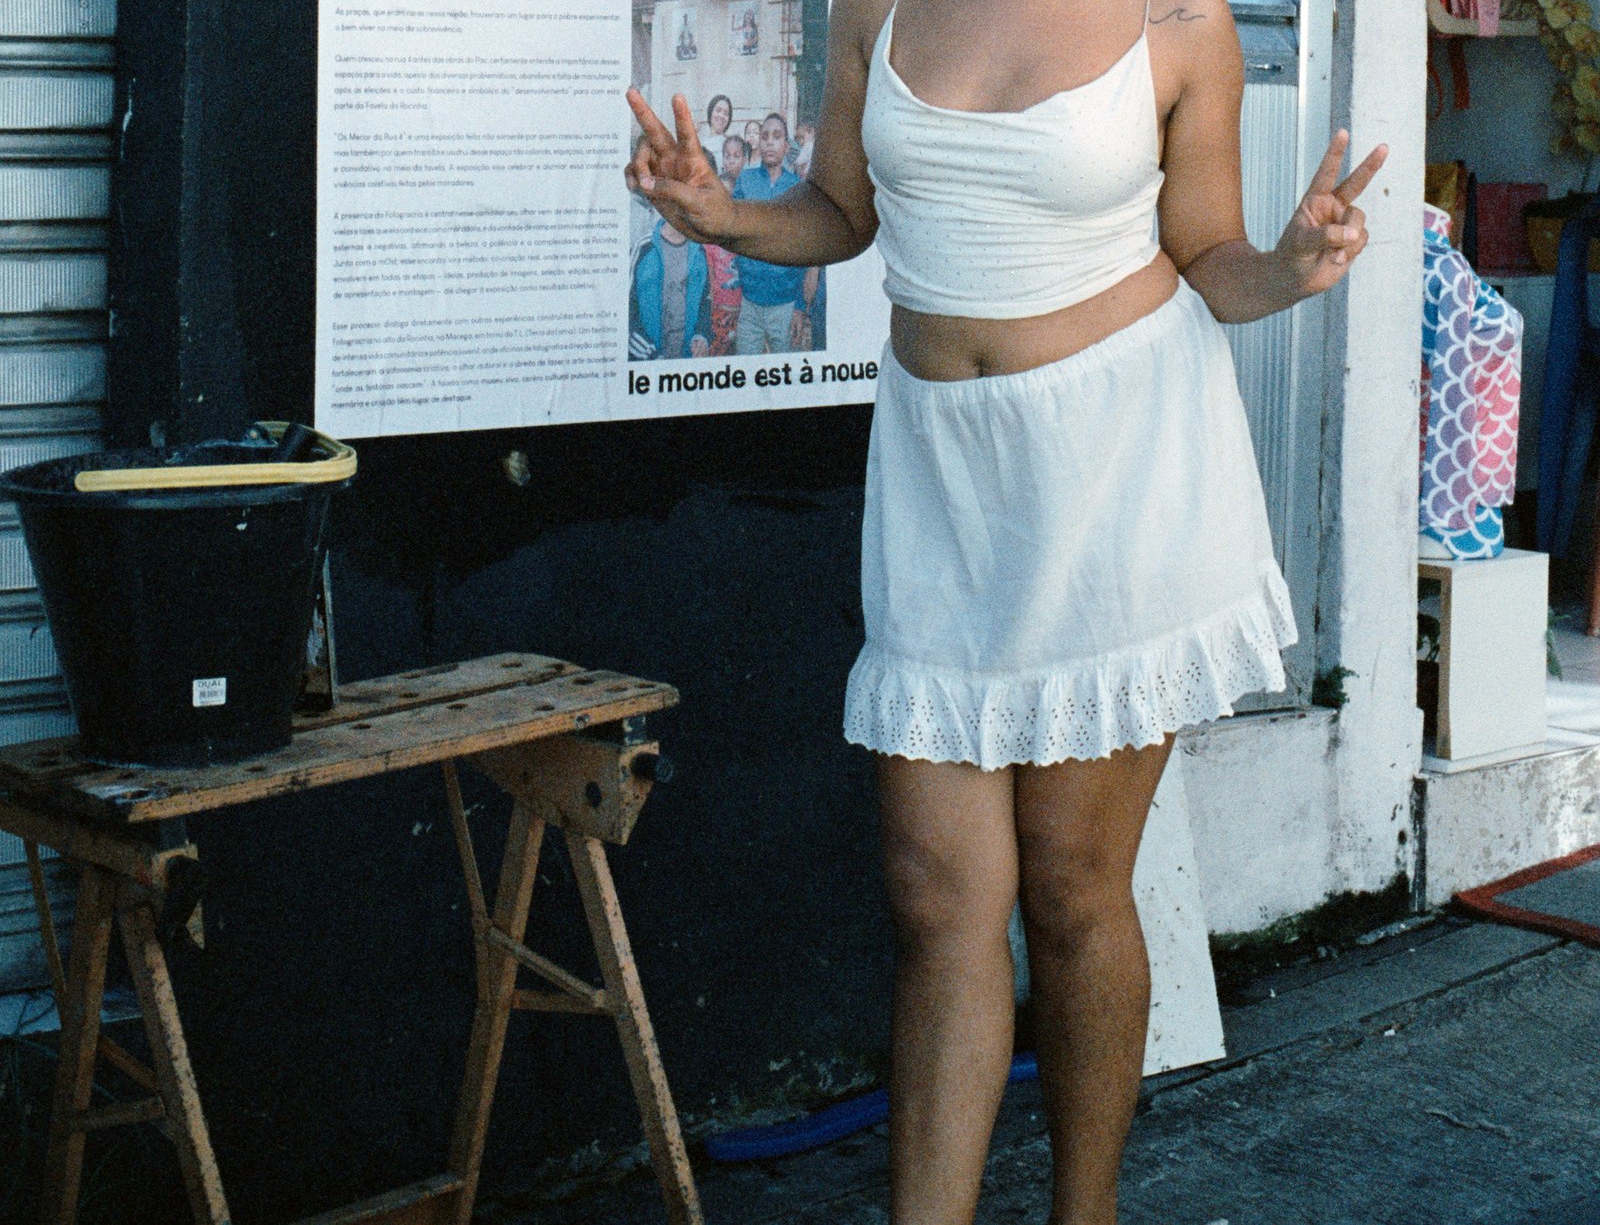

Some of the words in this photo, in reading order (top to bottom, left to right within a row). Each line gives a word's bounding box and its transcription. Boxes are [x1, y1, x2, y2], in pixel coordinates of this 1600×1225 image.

[628, 369, 651, 395] le
[658, 364, 747, 393] monde
[754, 363, 792, 388] est
[799, 357, 814, 385] à
[821, 361, 879, 383] noue
